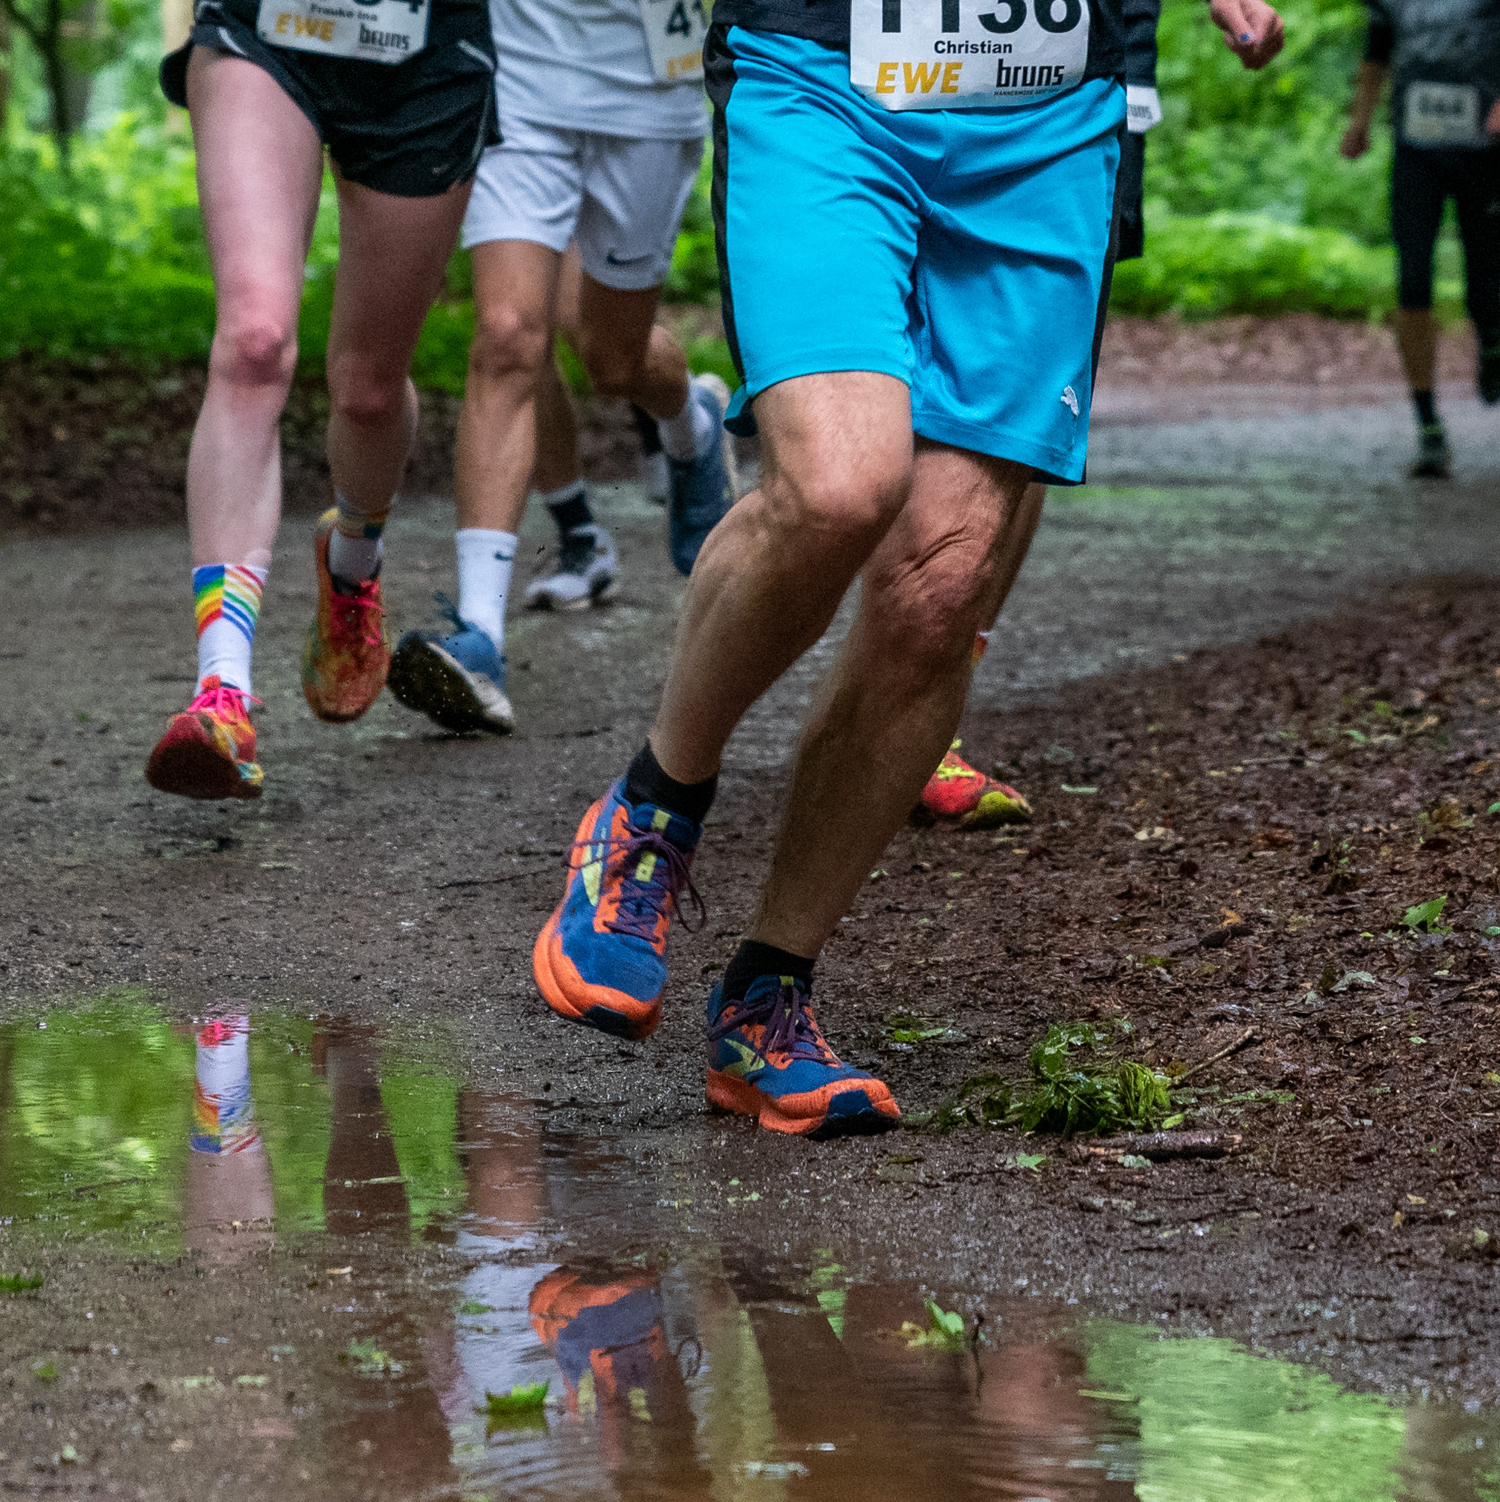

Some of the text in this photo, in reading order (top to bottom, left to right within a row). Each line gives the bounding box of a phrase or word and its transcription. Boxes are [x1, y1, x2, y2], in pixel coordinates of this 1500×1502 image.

[275, 12, 336, 42] EWE
[359, 22, 410, 50] bruns
[934, 40, 1012, 54] Christian
[875, 62, 963, 94] EWE
[996, 58, 1065, 87] bruns
